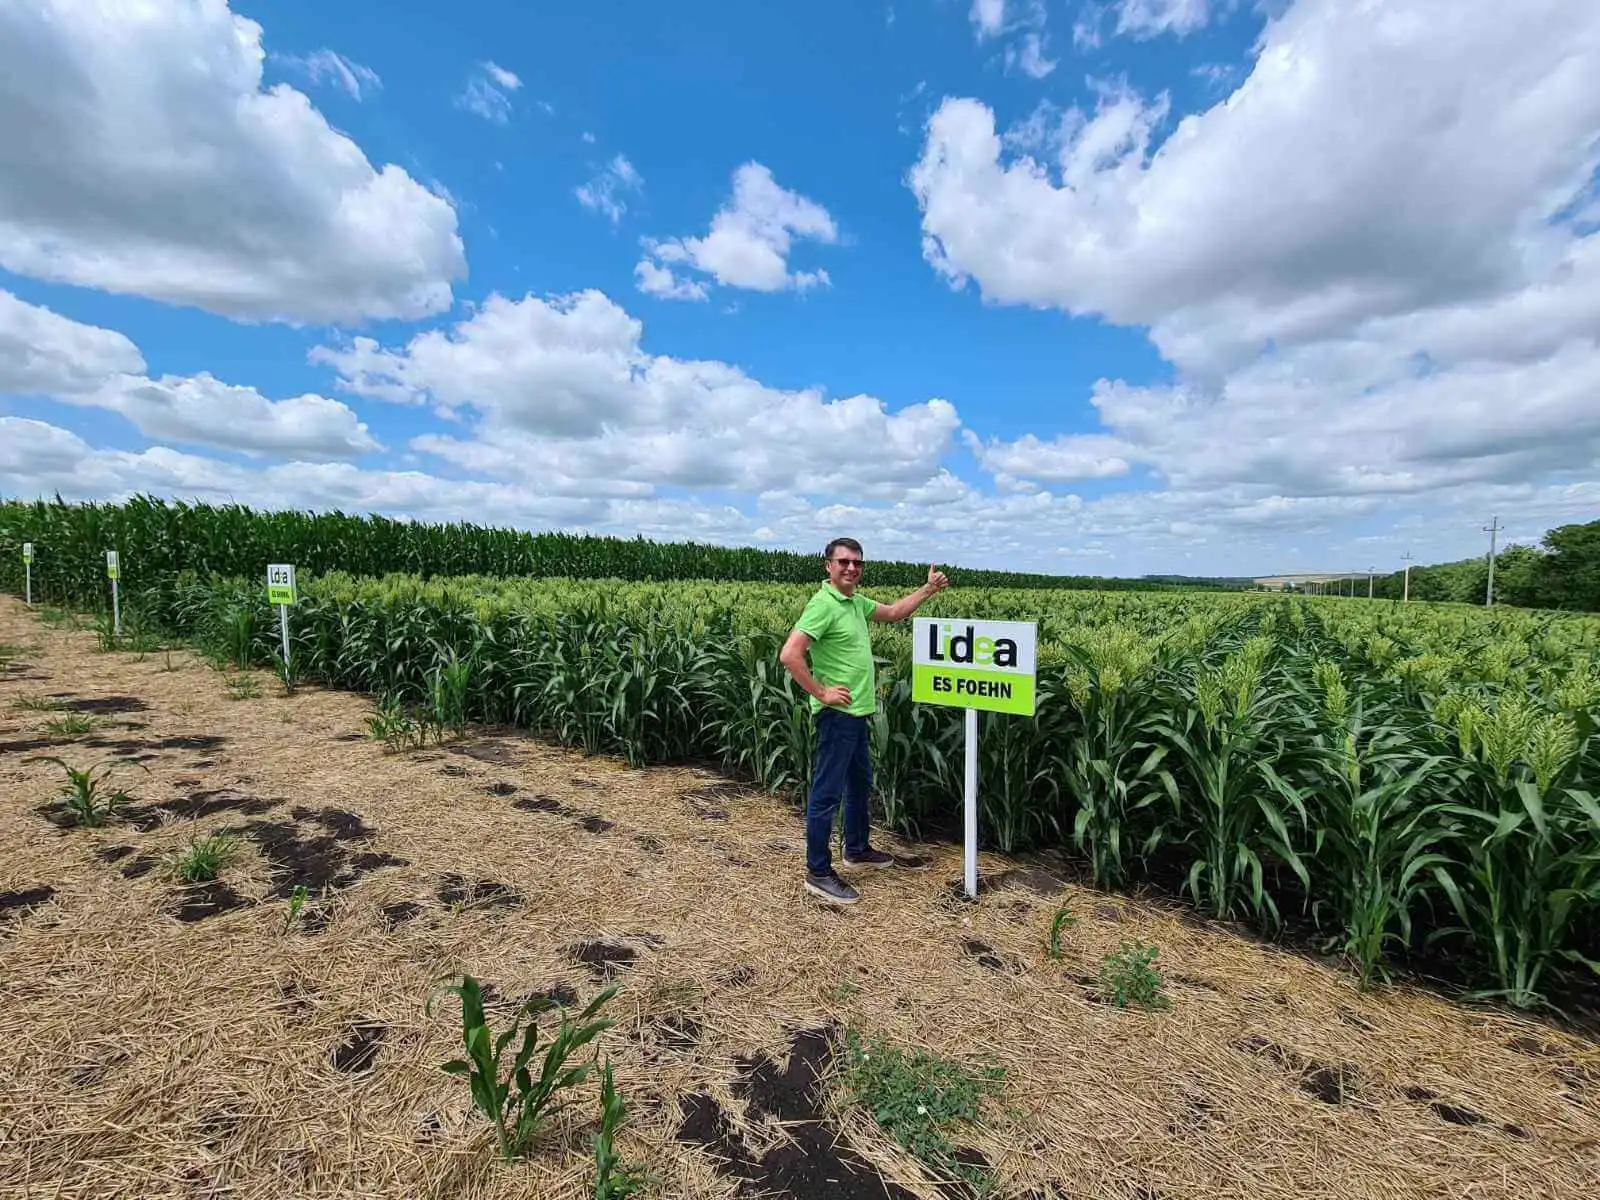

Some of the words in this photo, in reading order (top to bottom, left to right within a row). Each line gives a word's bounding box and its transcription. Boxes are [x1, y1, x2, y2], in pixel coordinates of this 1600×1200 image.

[929, 623, 1018, 668] Lidea
[933, 676, 952, 692] ES
[957, 678, 1012, 699] FOEHN
